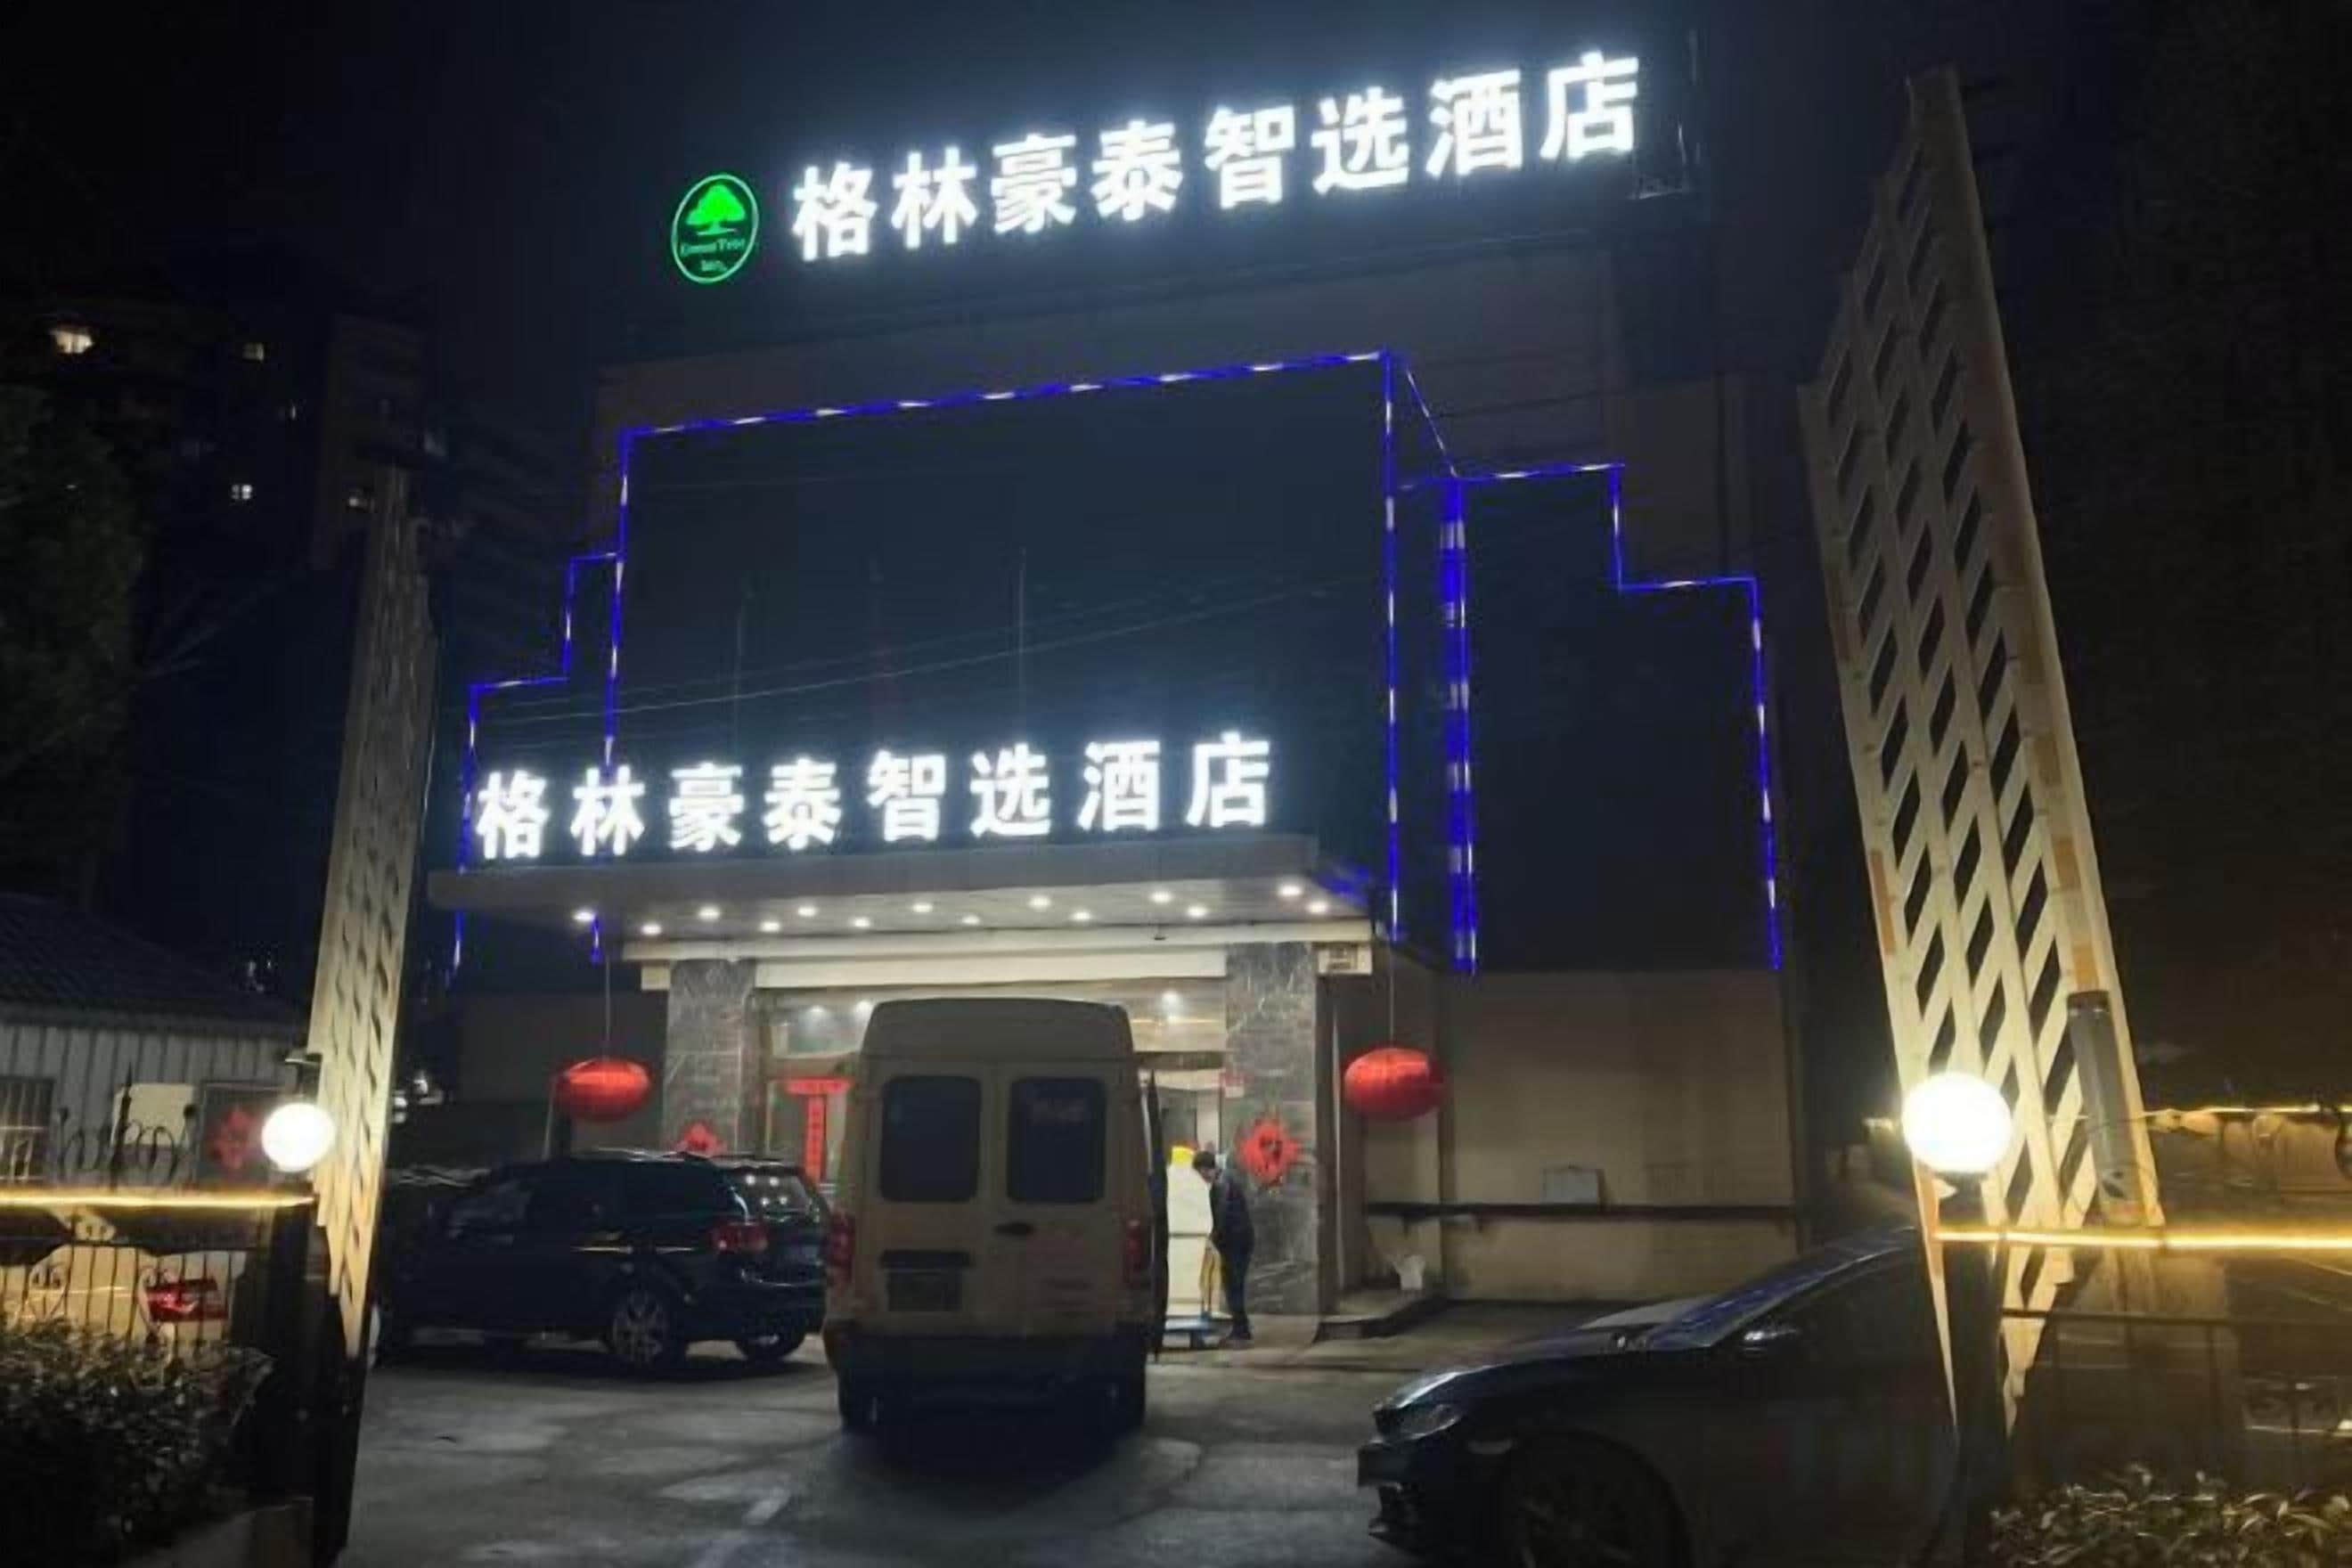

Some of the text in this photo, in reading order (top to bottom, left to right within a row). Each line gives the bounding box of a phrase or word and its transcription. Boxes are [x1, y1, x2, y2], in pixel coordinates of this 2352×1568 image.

[792, 51, 1638, 260] 格林豪泰智选酒店
[475, 731, 1270, 859] 格林豪泰智选酒店
